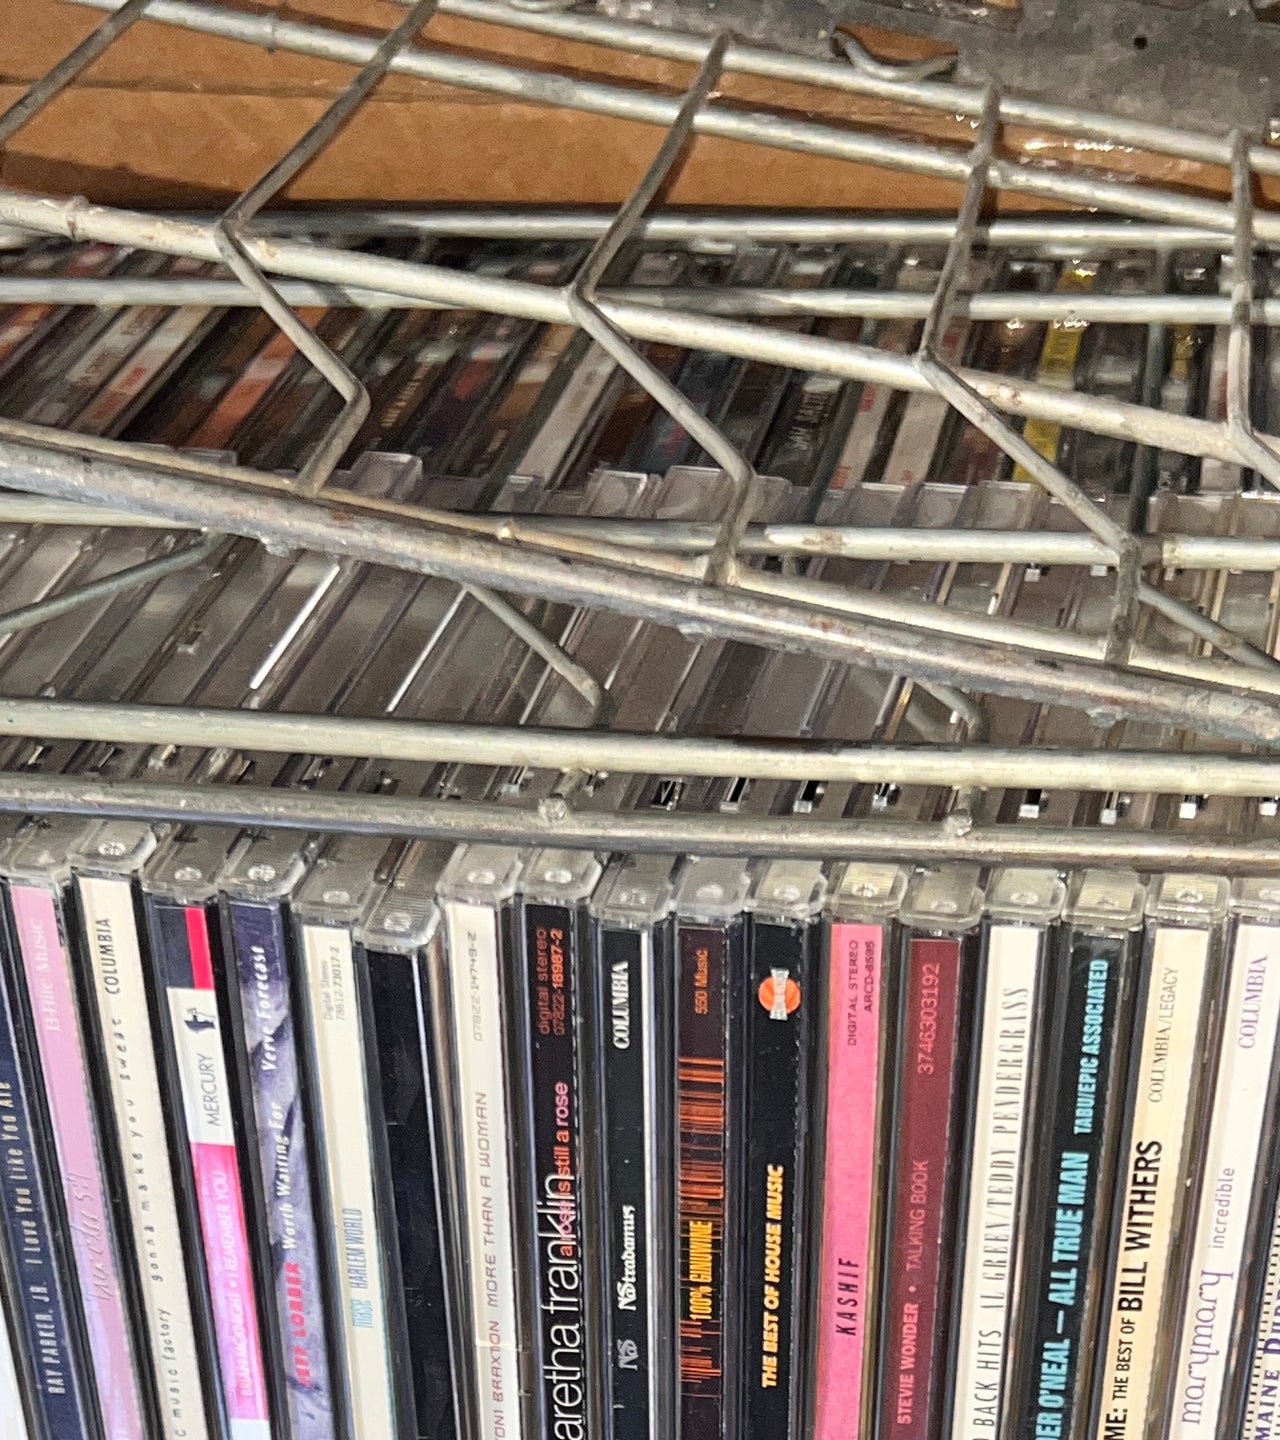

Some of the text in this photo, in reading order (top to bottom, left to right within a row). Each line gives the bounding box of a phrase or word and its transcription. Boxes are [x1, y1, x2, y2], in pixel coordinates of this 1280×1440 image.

[93, 916, 123, 994] COLUMBIA
[535, 927, 551, 1033] digital stereo
[846, 937, 862, 1045] DIGITAL STEREO
[611, 960, 630, 1048] COLUMBIA
[1237, 954, 1268, 1048] COLUMBIA
[1072, 958, 1110, 1134] TABU/EPIC ASSOCIATED
[197, 1051, 222, 1127] MERCURY
[4, 1147, 28, 1180] Like
[474, 1090, 491, 1168] WOMAN
[12, 1186, 34, 1213] You
[479, 1174, 492, 1188] A
[1058, 1151, 1090, 1204] MAN
[1123, 1138, 1163, 1252] WITHERS
[1208, 1166, 1236, 1248] incredible
[18, 1220, 41, 1252] Love
[480, 1195, 495, 1245] THAN
[1052, 1208, 1084, 1262] TRUE
[484, 1253, 498, 1307] MORE
[535, 1172, 584, 1440] aretha franklin
[689, 1219, 713, 1321] 100% GINUWINE
[761, 1163, 783, 1388] THE BEST OF HOUSE MUSIC
[836, 1256, 860, 1335] KASHIF
[896, 1160, 930, 1424] STEVIE WONDER TALKING BOOK
[1047, 1266, 1077, 1305] ALL
[1116, 1260, 1147, 1311] BILL
[28, 1281, 68, 1394] RAY PARKER, JR.
[488, 1319, 503, 1402] BRAXTON
[976, 1328, 1002, 1369] HITS
[1115, 1338, 1134, 1371] BEST
[1120, 1316, 1137, 1333] OF
[972, 1381, 998, 1426] BACK
[1037, 1337, 1071, 1408] O'NEAL
[1112, 1375, 1129, 1401] THE
